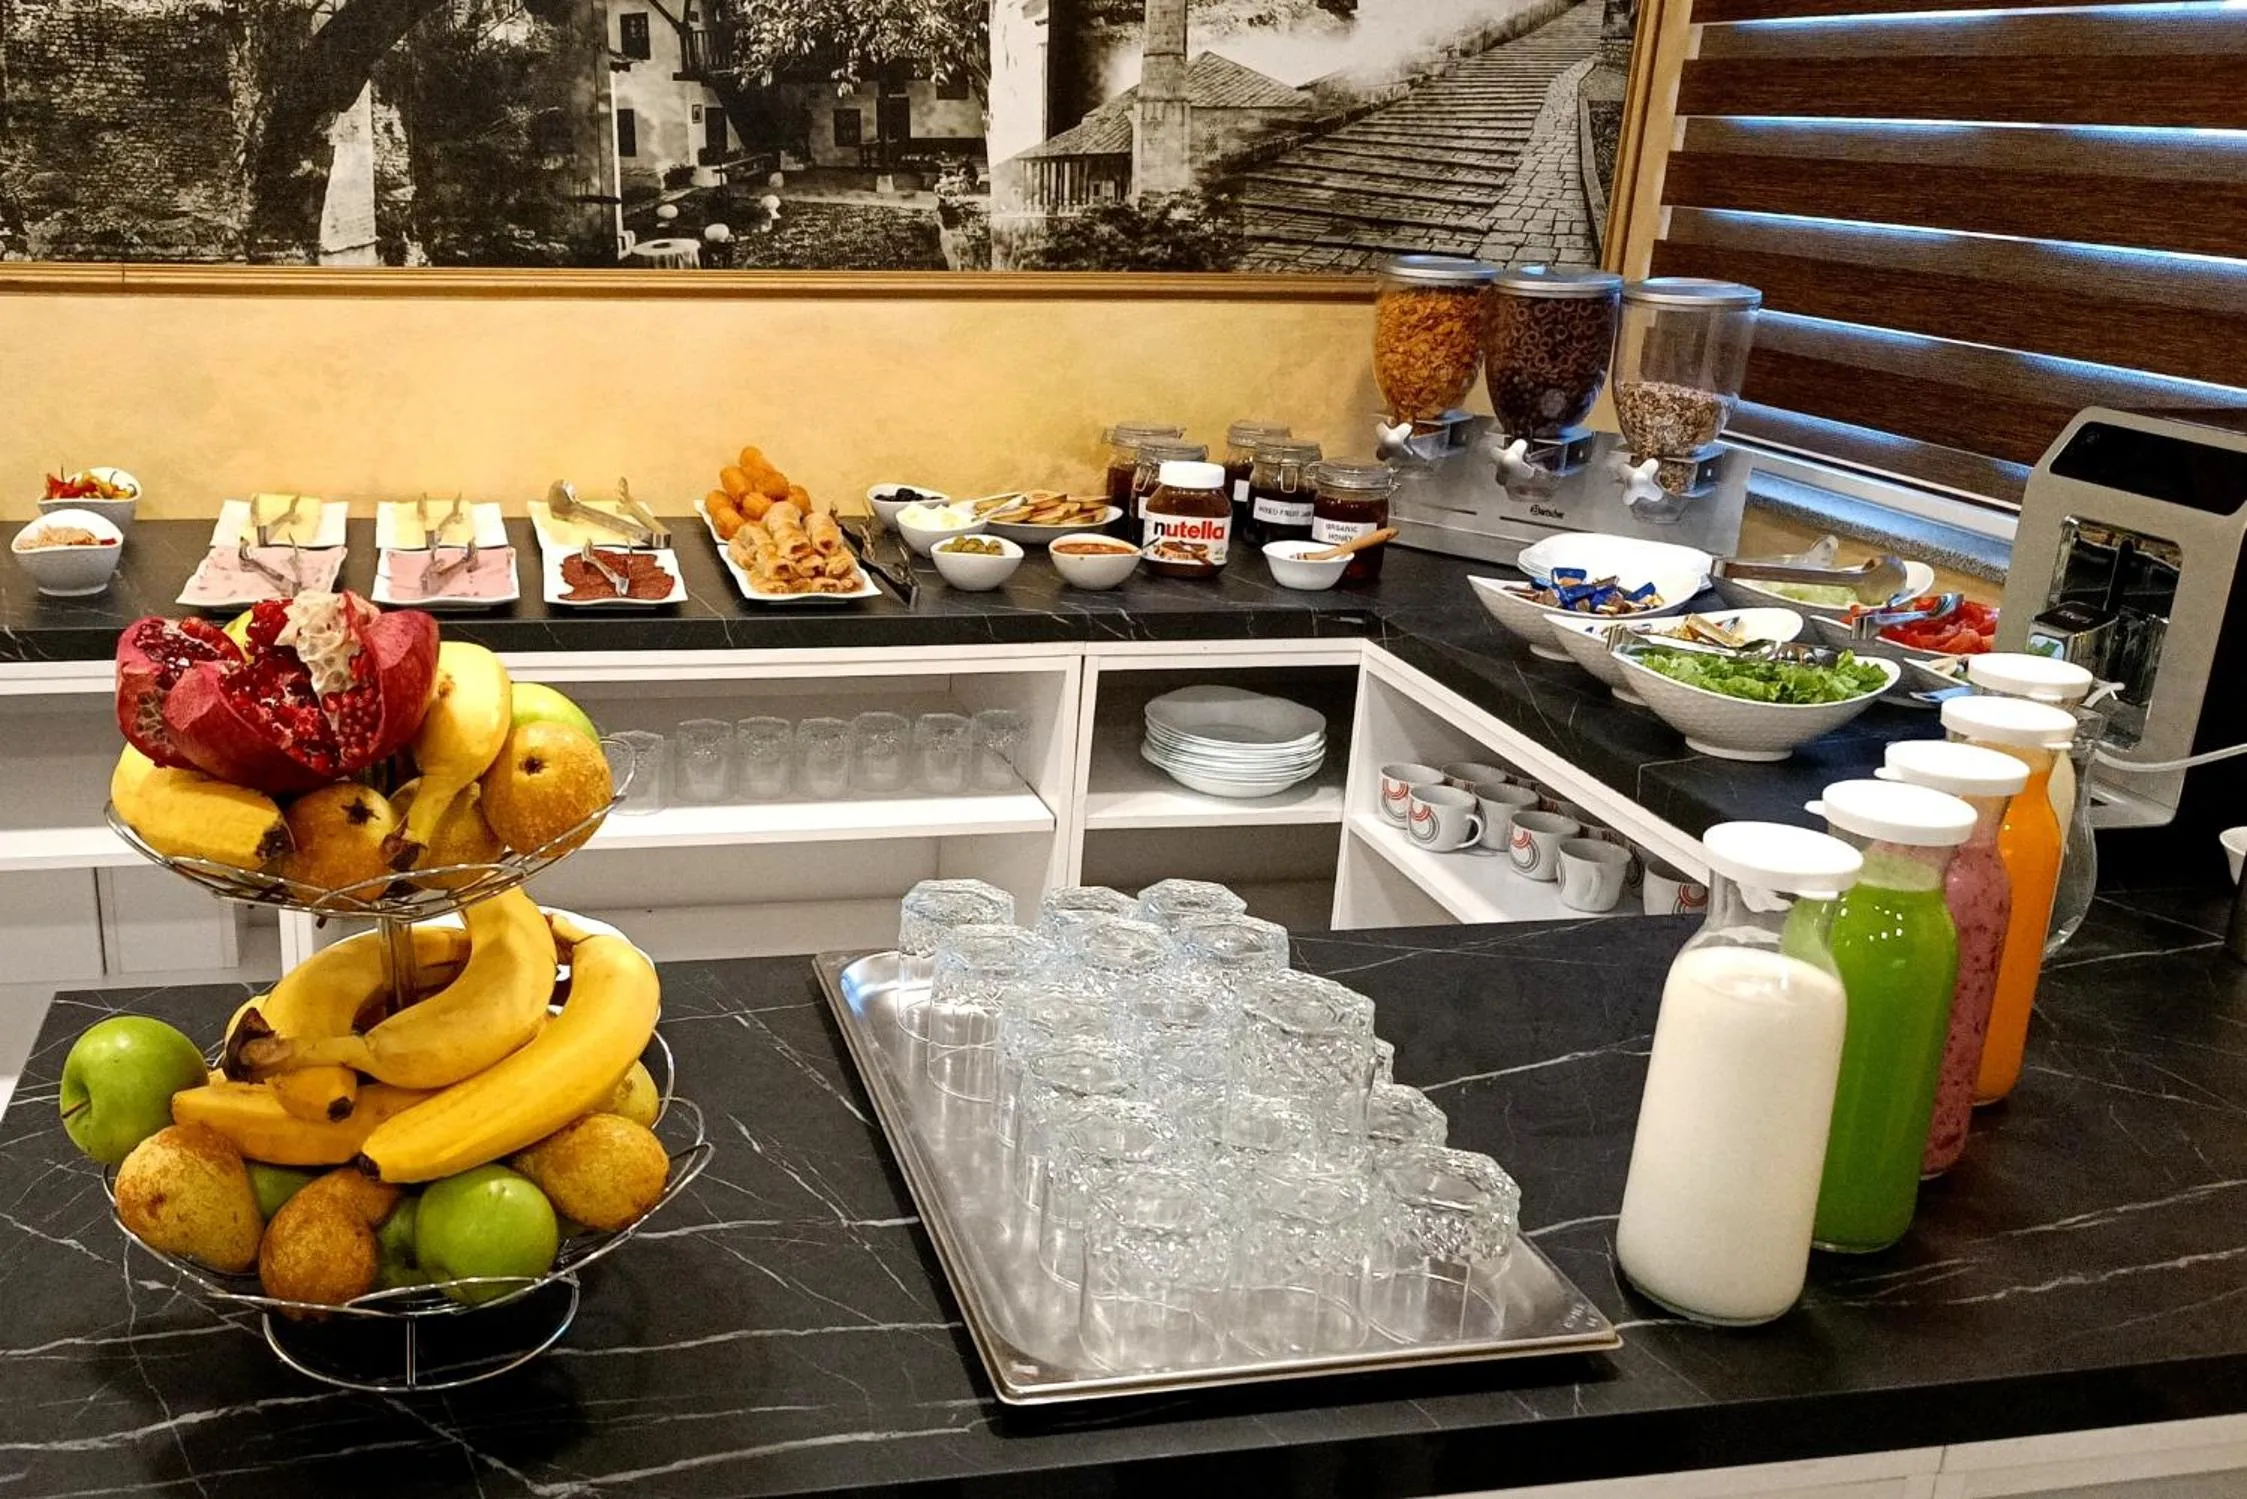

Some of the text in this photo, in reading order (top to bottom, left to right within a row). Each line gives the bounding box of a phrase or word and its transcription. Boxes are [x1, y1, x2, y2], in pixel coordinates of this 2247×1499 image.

[1154, 521, 1225, 540] nutella
[1325, 523, 1358, 533] ORGANIC
[1328, 533, 1353, 542] HONEY
